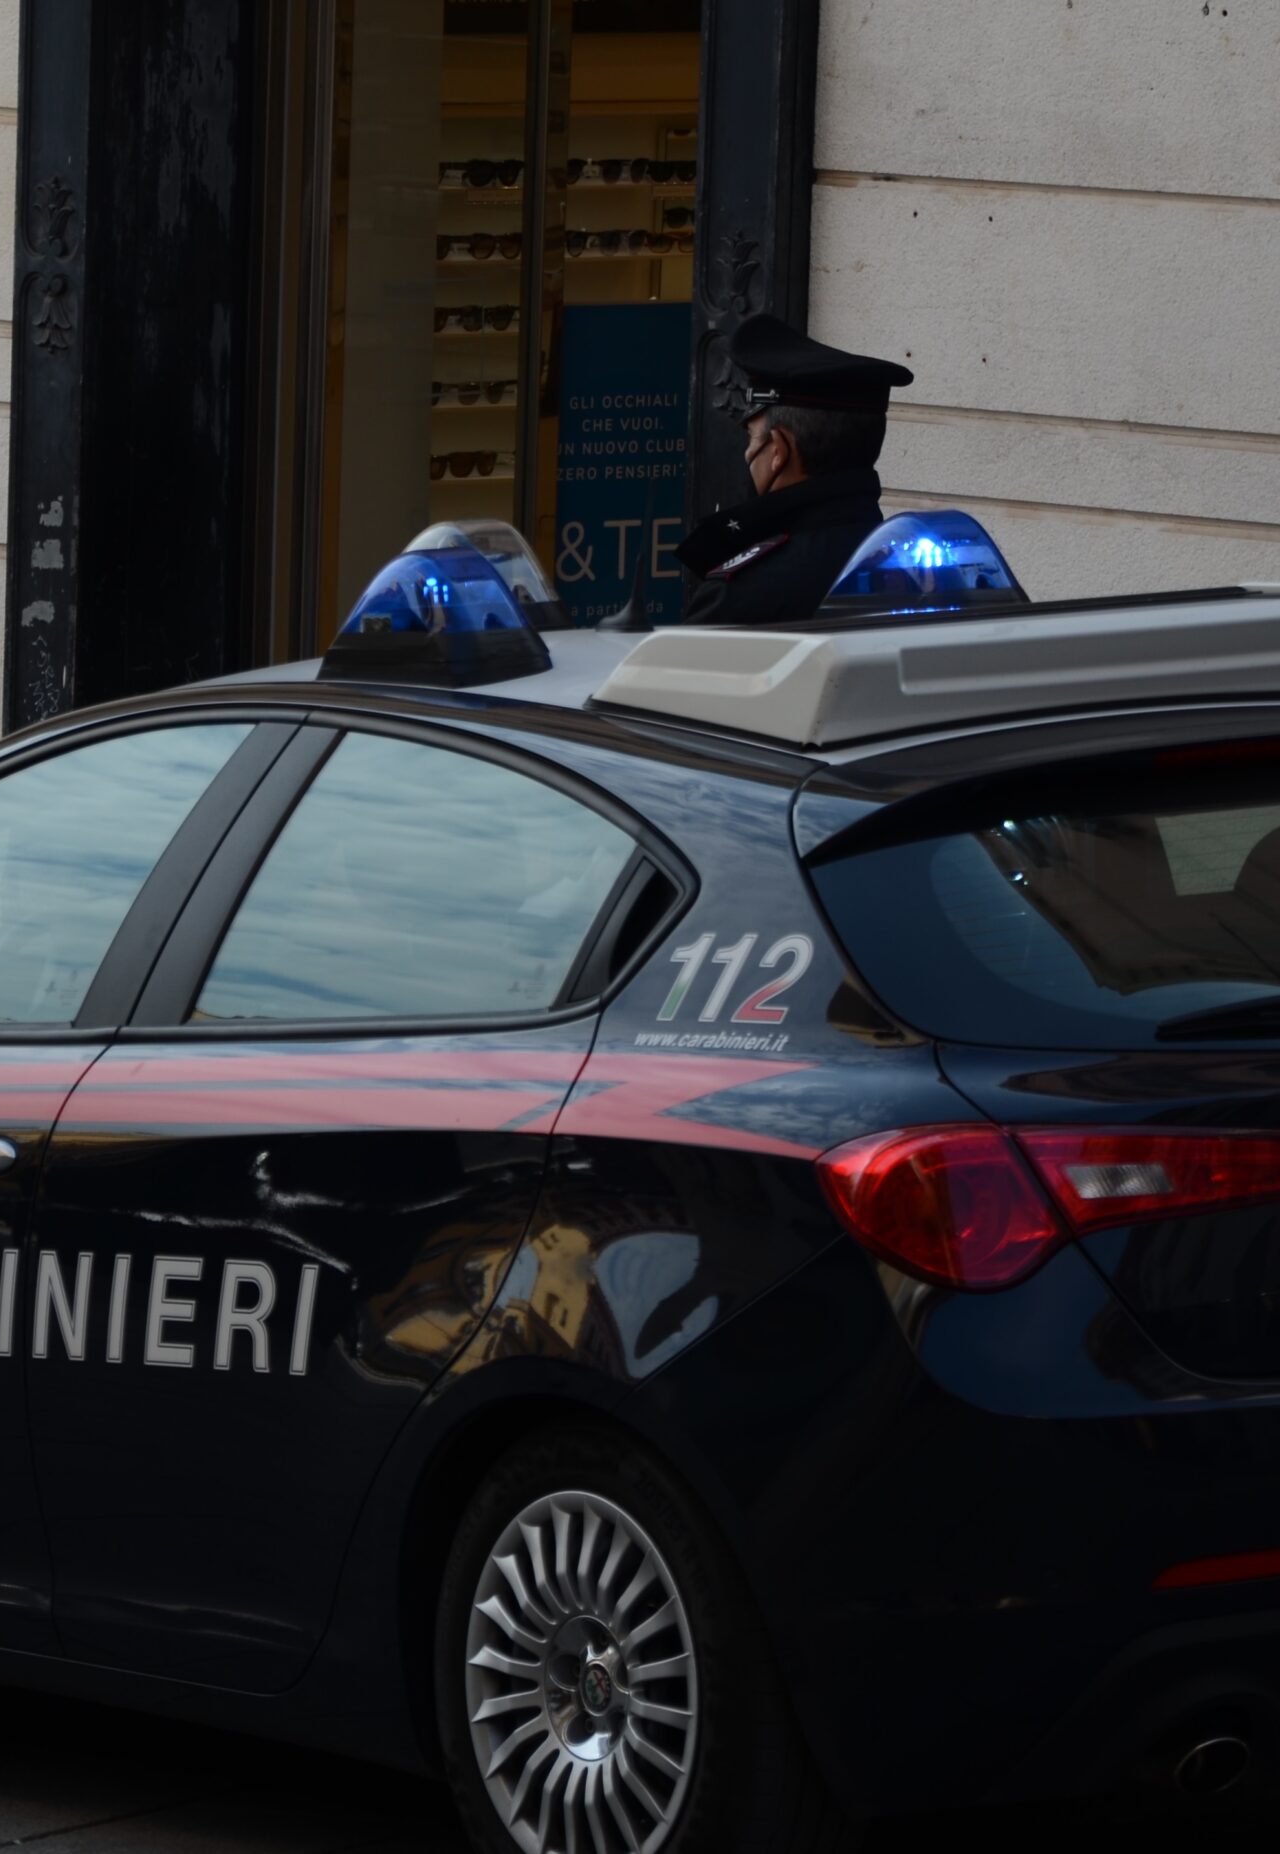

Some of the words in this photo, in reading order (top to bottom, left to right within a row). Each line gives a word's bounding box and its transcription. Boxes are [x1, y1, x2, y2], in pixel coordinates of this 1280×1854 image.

[569, 395, 595, 410] GLI
[601, 393, 678, 409] OCCHIALI
[581, 418, 614, 432] CHE
[621, 416, 664, 431] VUOI.
[582, 440, 639, 455] NUOVO
[646, 438, 686, 453] CLUB
[554, 466, 597, 480] ZERO
[556, 520, 596, 582] &
[602, 517, 683, 581] TE
[656, 932, 815, 1024] 112
[634, 1031, 790, 1051] www.carabinieri.it
